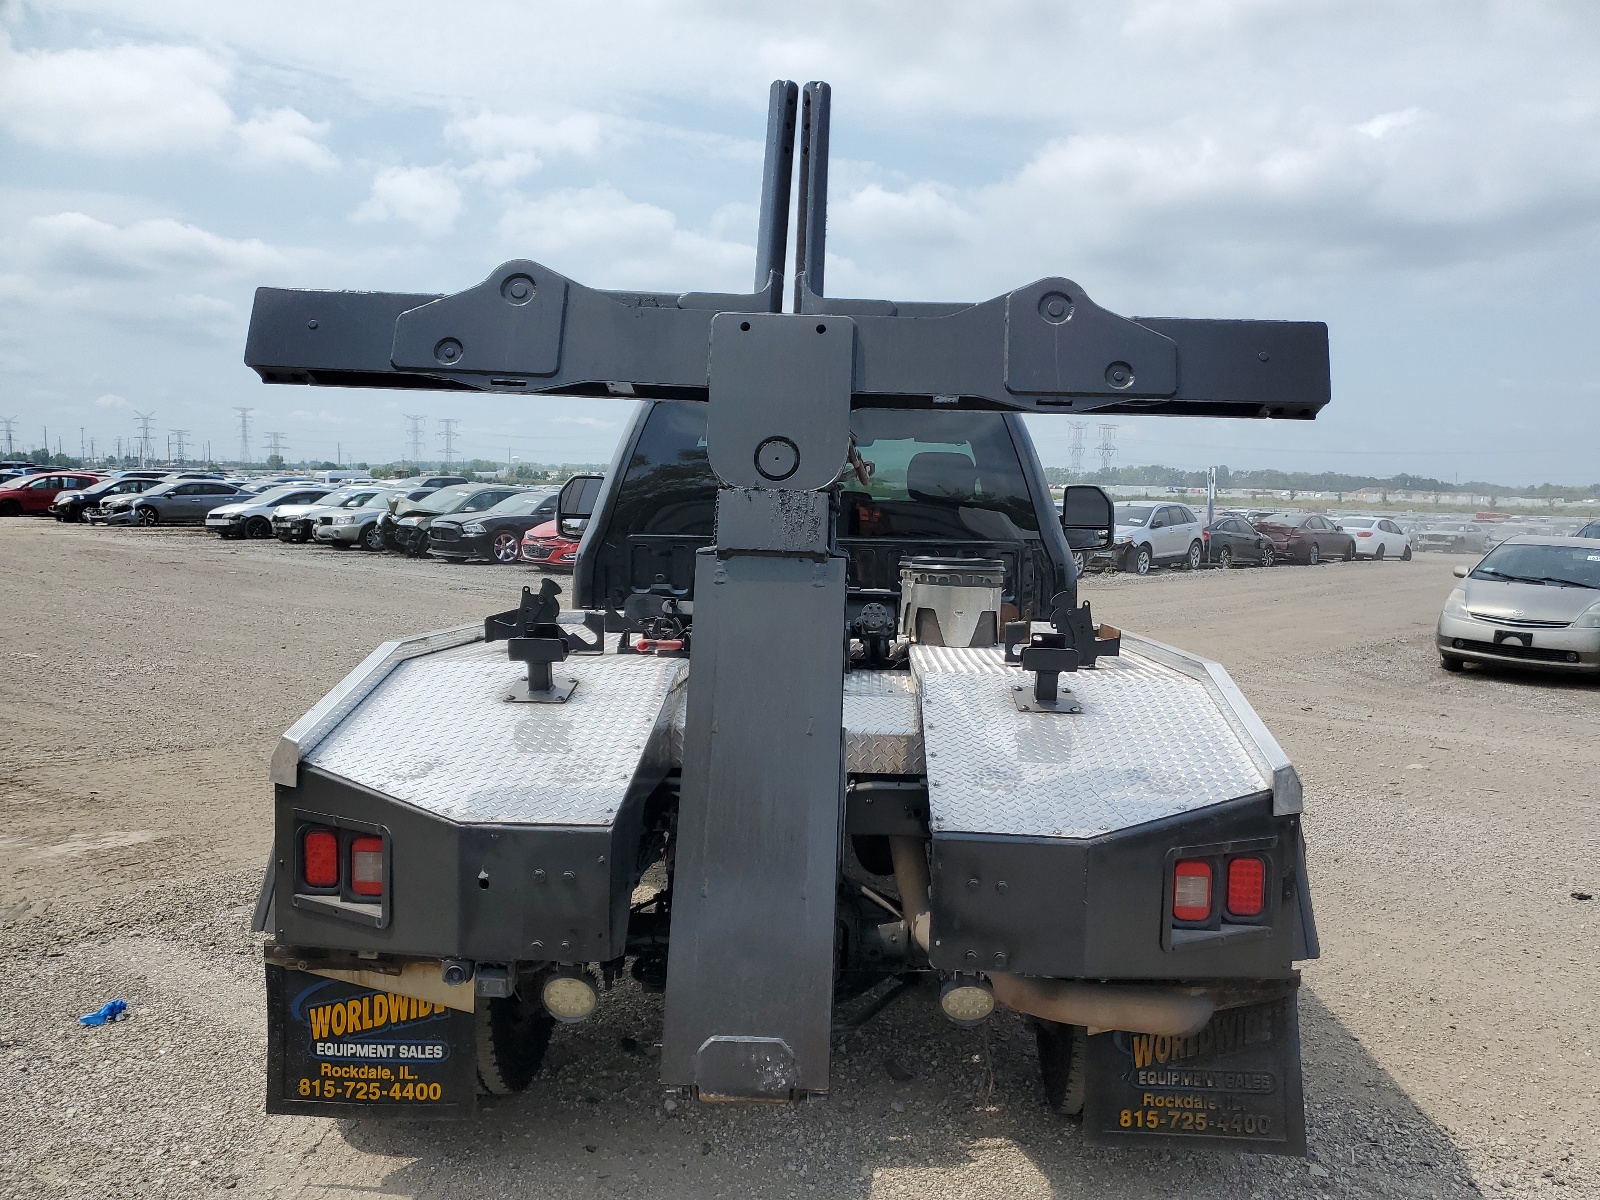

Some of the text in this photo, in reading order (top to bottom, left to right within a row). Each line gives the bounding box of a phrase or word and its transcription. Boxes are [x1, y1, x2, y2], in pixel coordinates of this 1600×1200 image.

[316, 1042, 443, 1059] EQUIPMENT SALES
[320, 1063, 419, 1082] Rockdale, IL.
[1138, 1071, 1271, 1089] EQUIPMENT SALES
[299, 1078, 442, 1101] 815-725-4400
[1119, 1110, 1271, 1134] 815-725-4400
